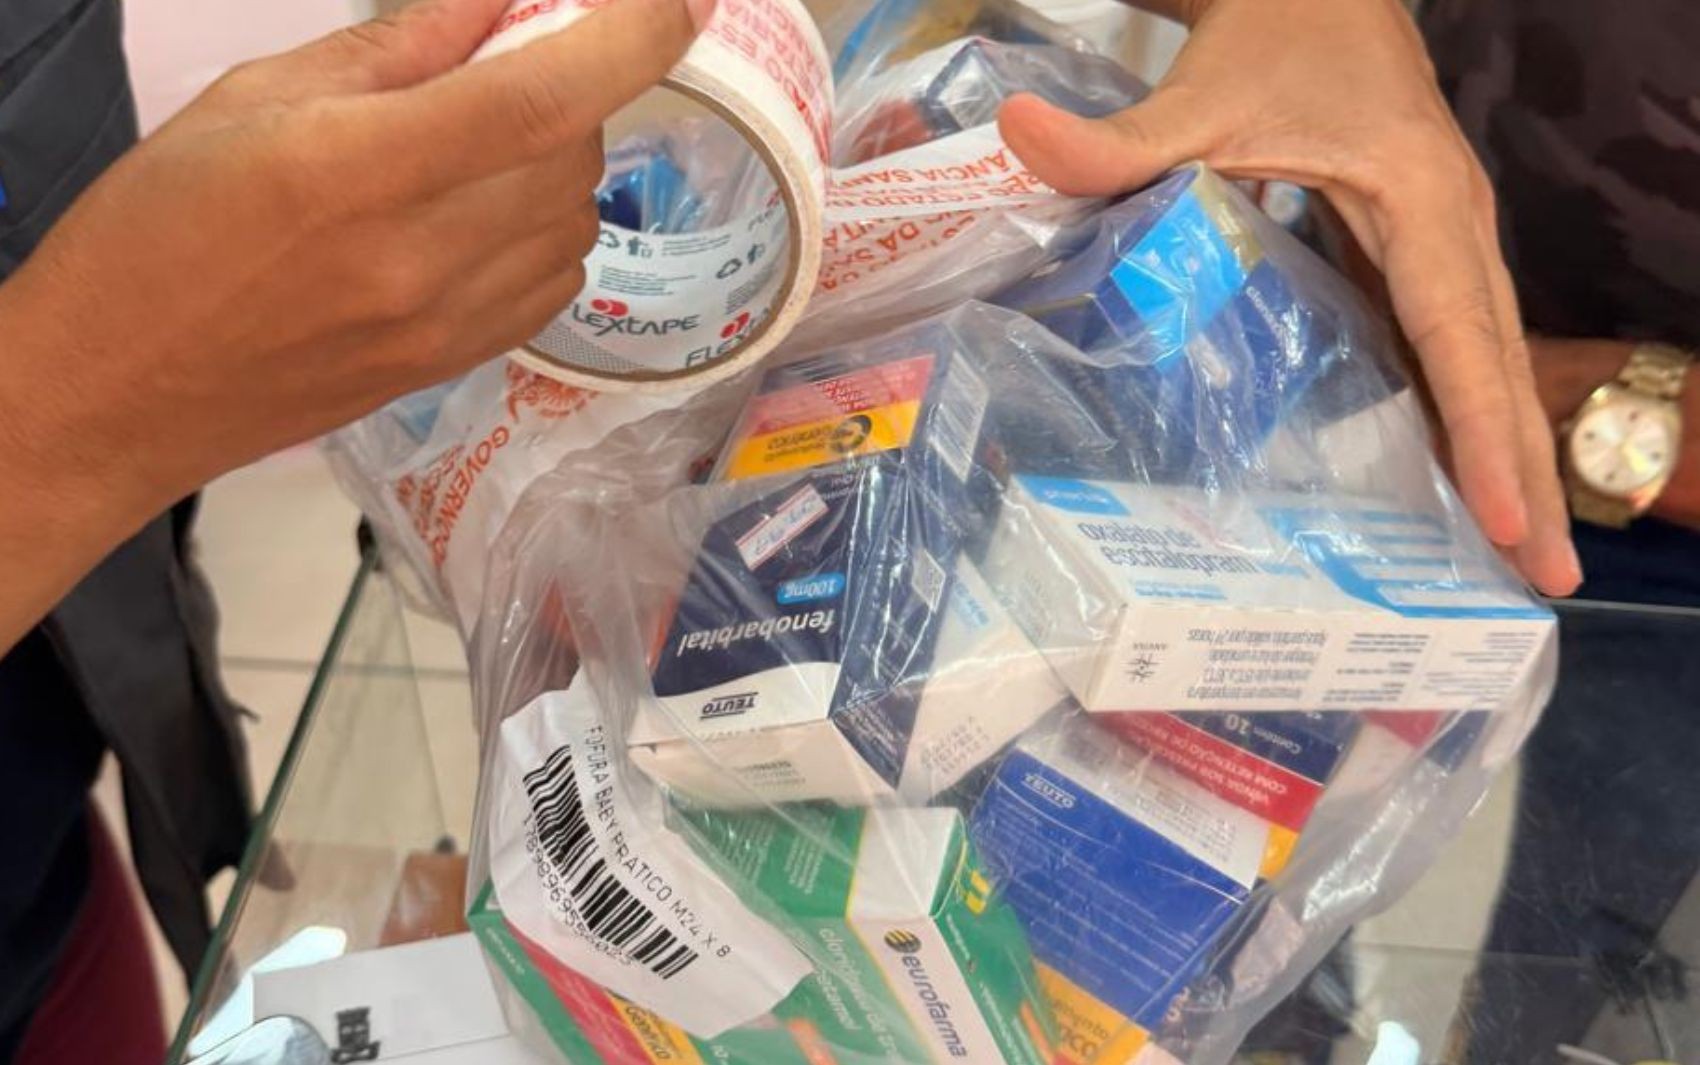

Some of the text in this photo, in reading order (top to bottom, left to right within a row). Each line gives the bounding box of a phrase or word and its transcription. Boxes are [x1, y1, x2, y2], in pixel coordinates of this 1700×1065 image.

[916, 149, 1011, 181] ÂNCIA
[572, 302, 701, 337] LEXTAPE
[675, 608, 836, 657] fenobarbital
[701, 694, 757, 716] TEUTO
[1224, 713, 1250, 735] 10
[1253, 776, 1287, 796] COM
[611, 831, 673, 902] PRATICO
[671, 899, 704, 937] M24
[715, 944, 731, 958] 8
[902, 955, 968, 1057] eurofarma
